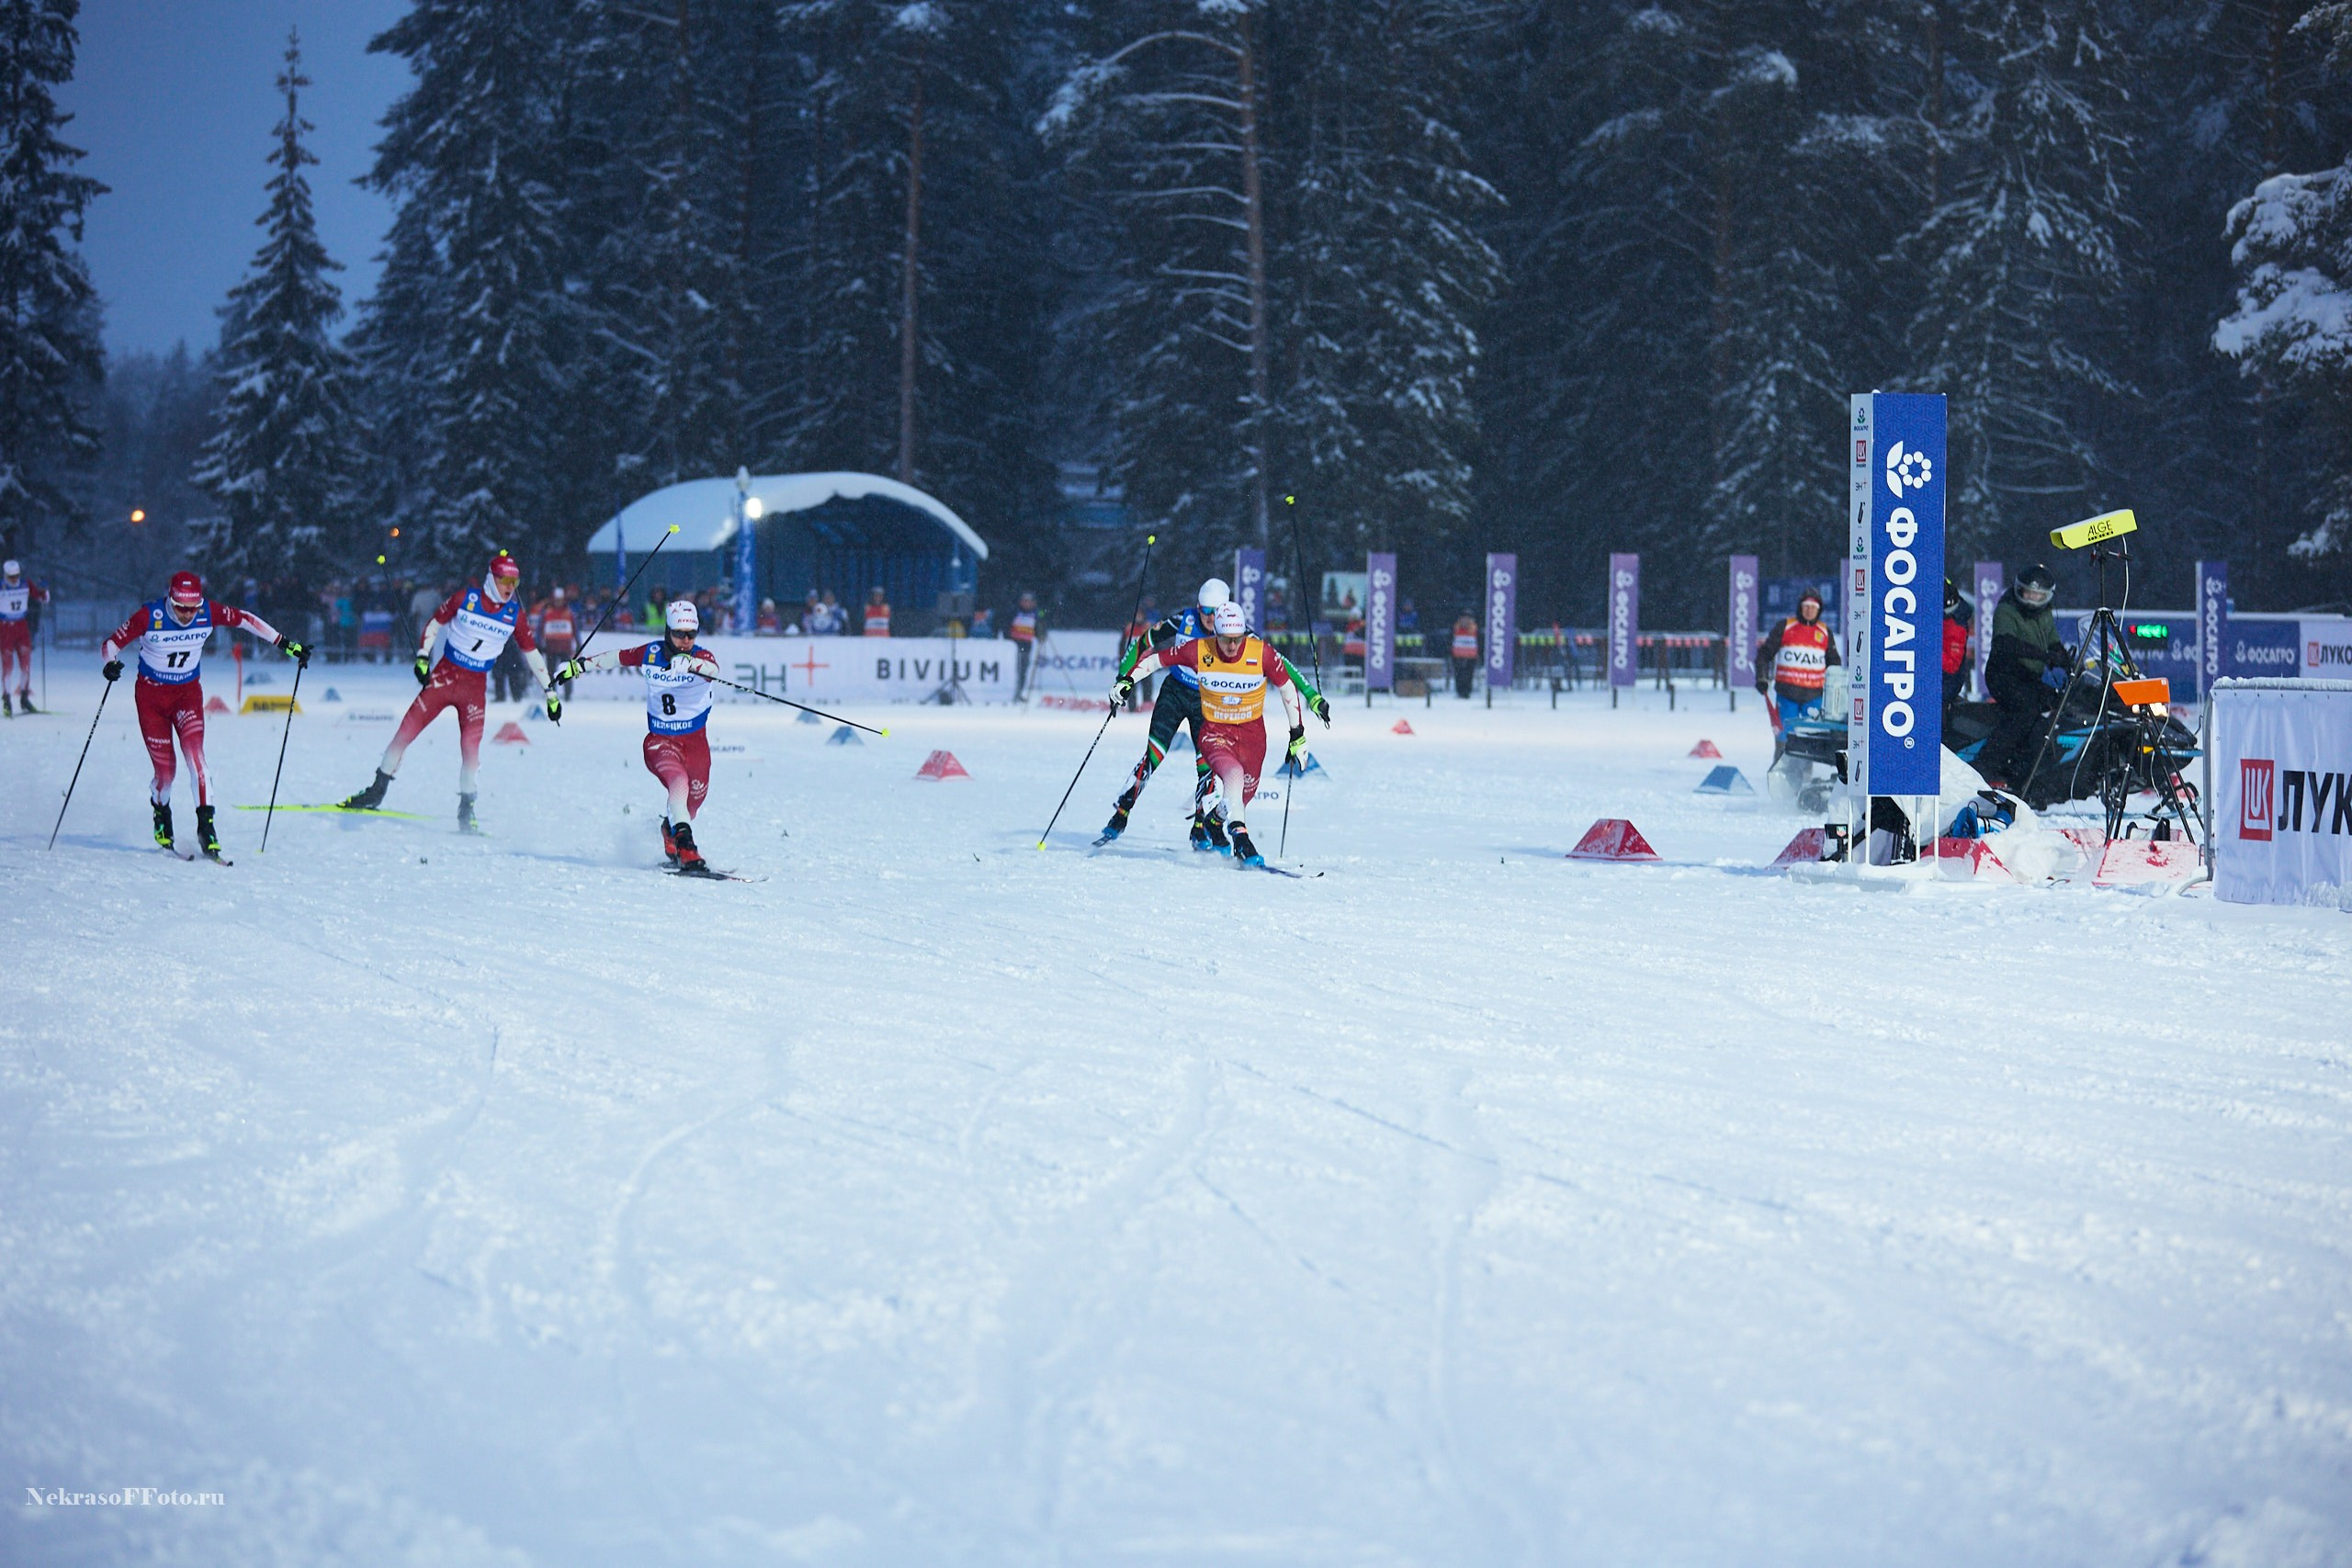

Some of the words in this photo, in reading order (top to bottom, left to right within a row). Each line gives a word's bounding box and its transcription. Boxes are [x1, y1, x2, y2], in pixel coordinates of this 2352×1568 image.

[2087, 520, 2111, 536] ALGE
[10, 601, 21, 611] 12
[469, 619, 508, 637] ФОСАГРО
[2206, 598, 2218, 675] ФОСАГРО
[163, 632, 207, 642] ФОСАГРО
[167, 651, 190, 668] 17
[2247, 647, 2295, 664] ФОСАГРО
[876, 657, 1001, 682] BIVIUM
[662, 694, 676, 716] 8
[2278, 770, 2352, 835] ЛУК
